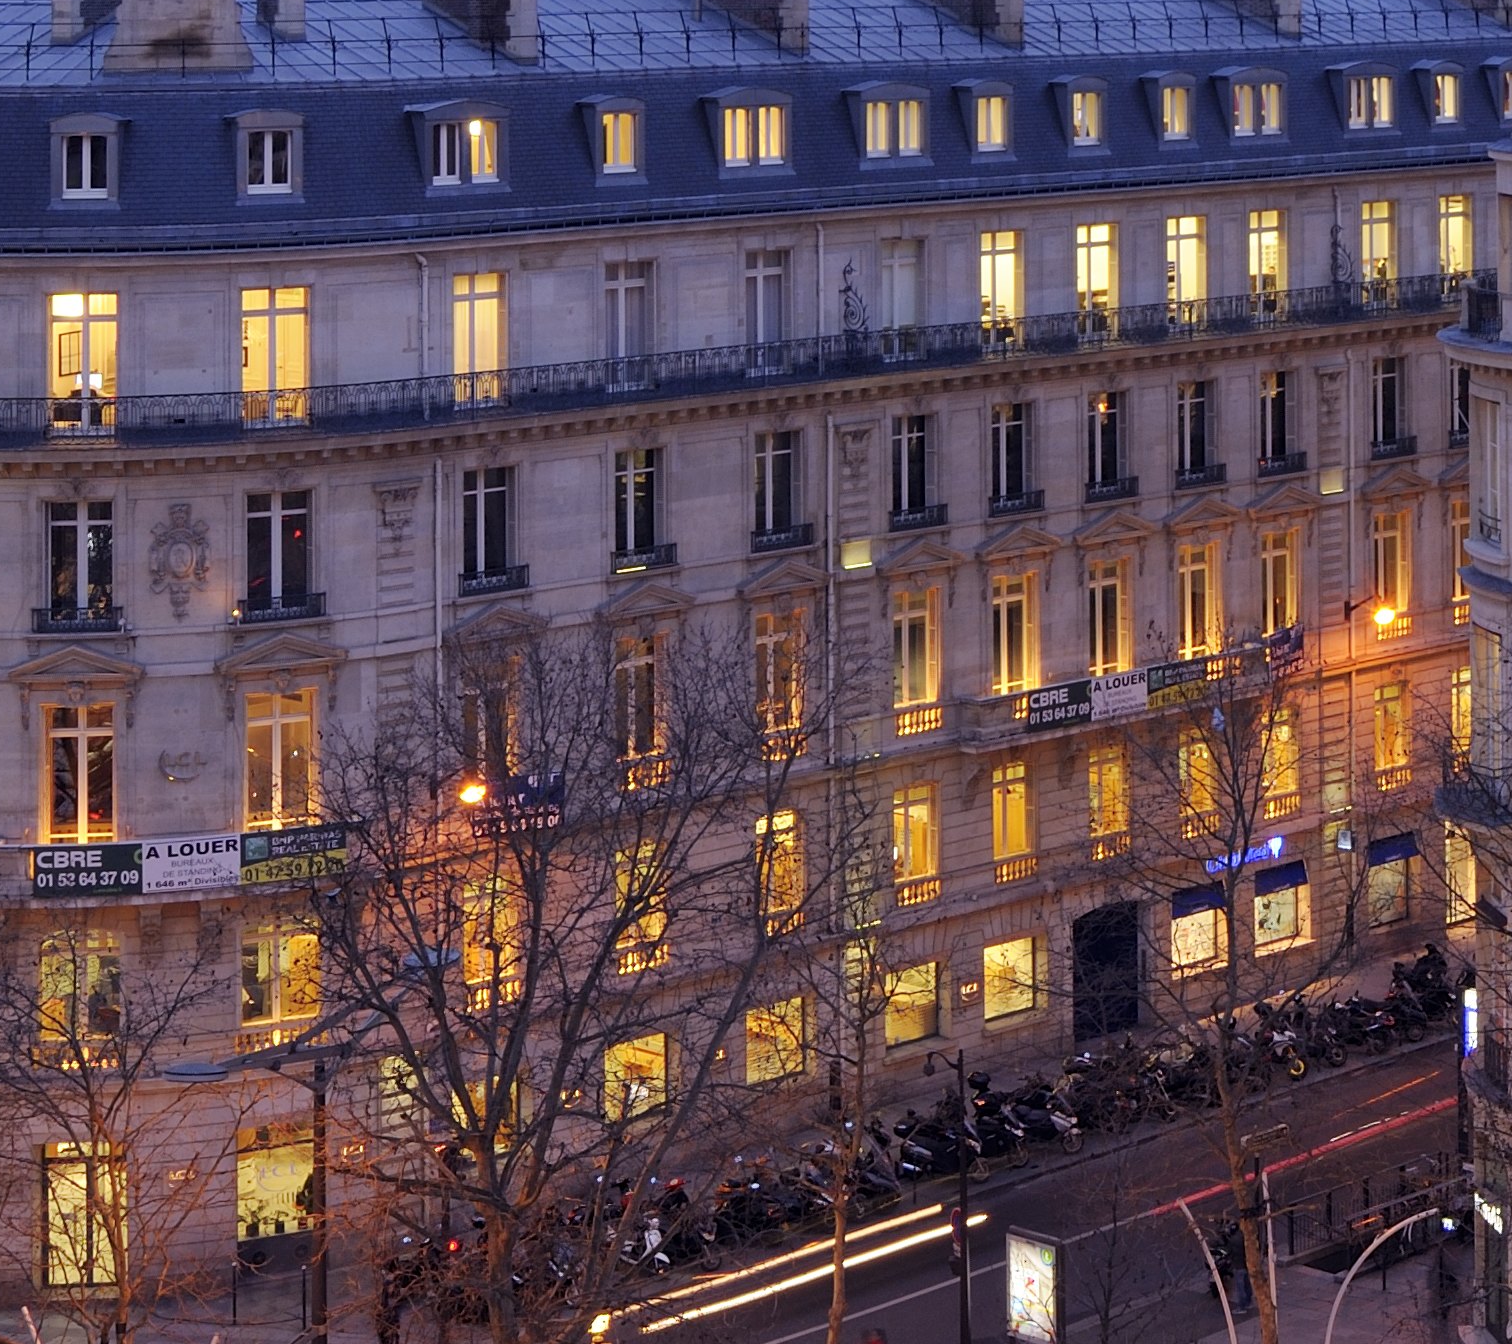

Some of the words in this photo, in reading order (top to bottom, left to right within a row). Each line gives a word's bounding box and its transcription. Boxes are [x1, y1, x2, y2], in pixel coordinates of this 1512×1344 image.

[1093, 681, 1102, 693] A
[1105, 672, 1146, 690] LOUER
[1029, 688, 1069, 707] CBRE
[1030, 712, 1039, 725] 01
[1042, 709, 1053, 722] 53
[1054, 706, 1066, 719] 64
[1067, 704, 1078, 717] 37
[36, 850, 103, 869] CBRE
[145, 846, 160, 860] A
[167, 839, 239, 858] LOUER
[37, 872, 54, 888] 01
[78, 872, 97, 887] 64
[99, 871, 118, 886] 37
[120, 869, 139, 885] 09
